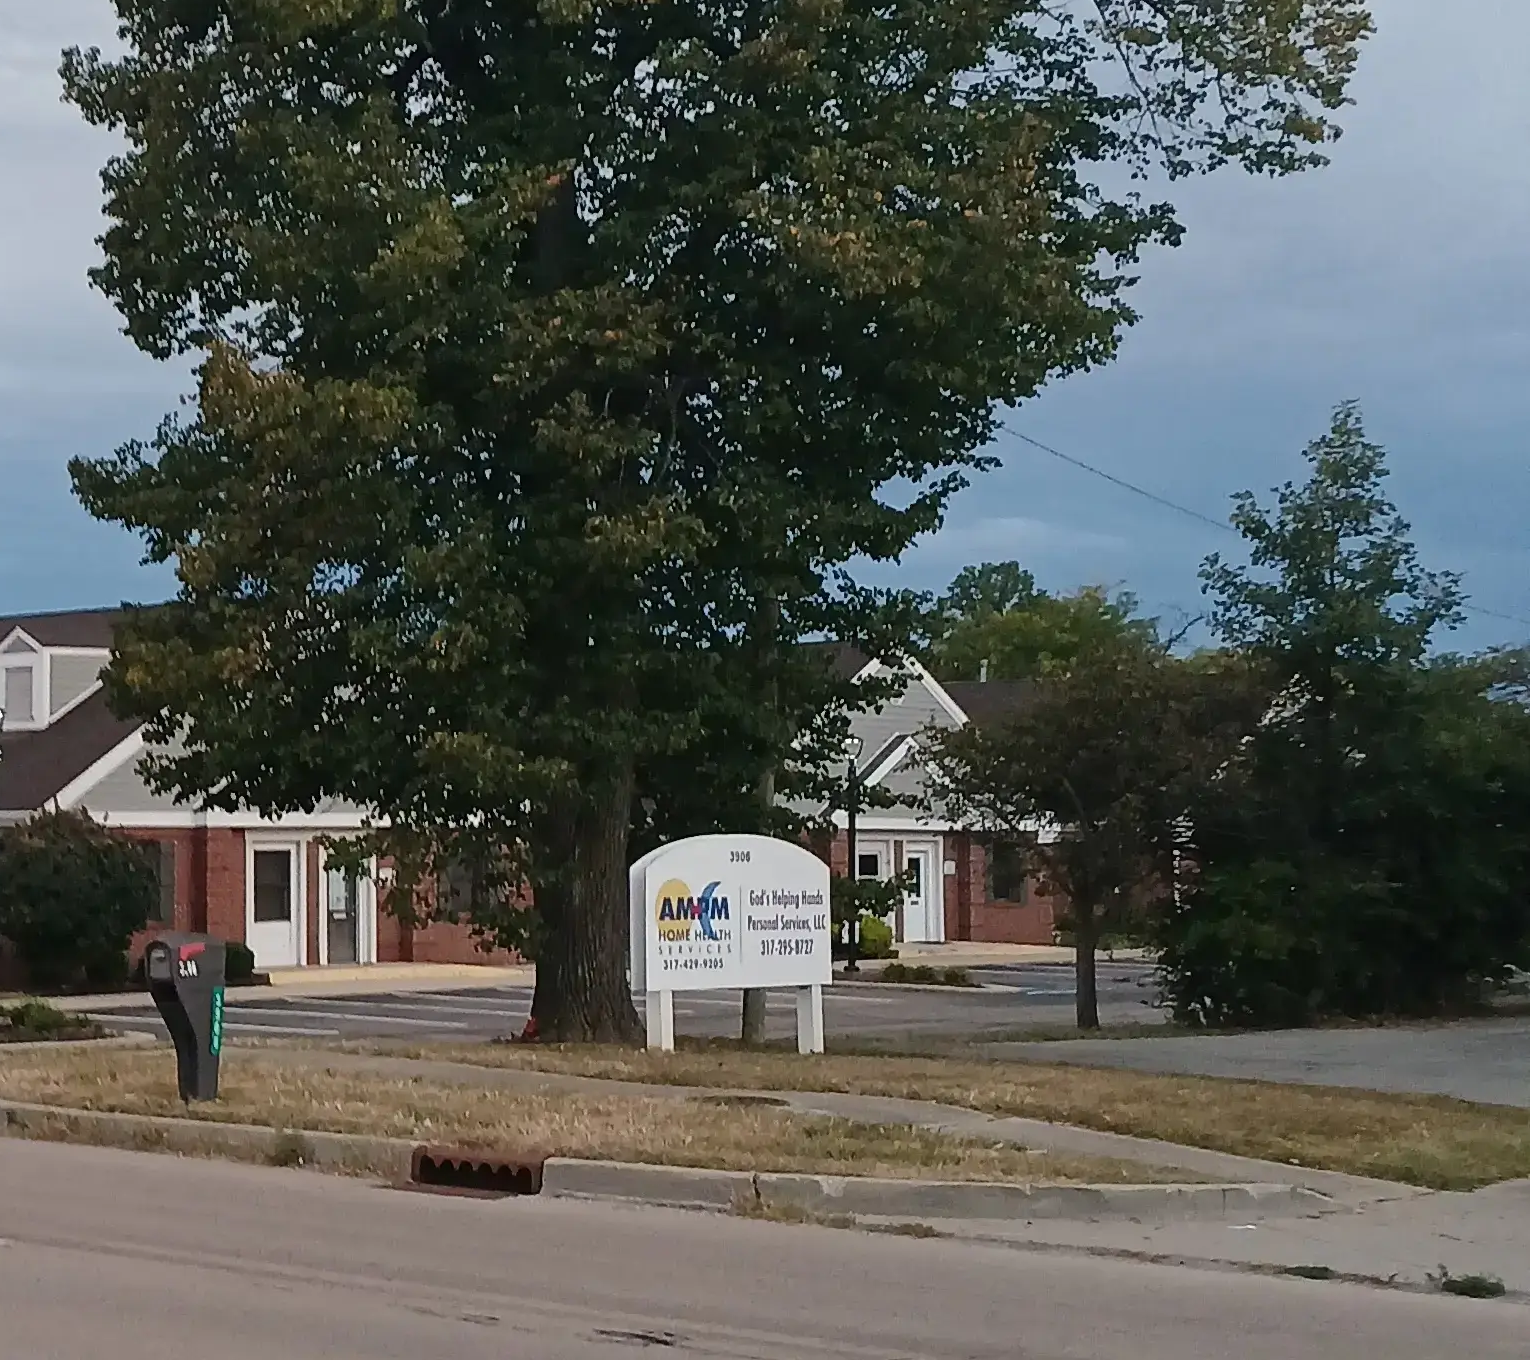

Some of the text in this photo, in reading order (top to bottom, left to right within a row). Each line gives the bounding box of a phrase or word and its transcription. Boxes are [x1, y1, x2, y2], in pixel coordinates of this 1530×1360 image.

[730, 850, 751, 862] 3906
[749, 888, 823, 909] God's Helping Hands
[747, 913, 779, 931] Personal
[813, 914, 826, 931] LLC
[658, 928, 731, 942] HOME HEALTH
[658, 943, 731, 956] SERVICES
